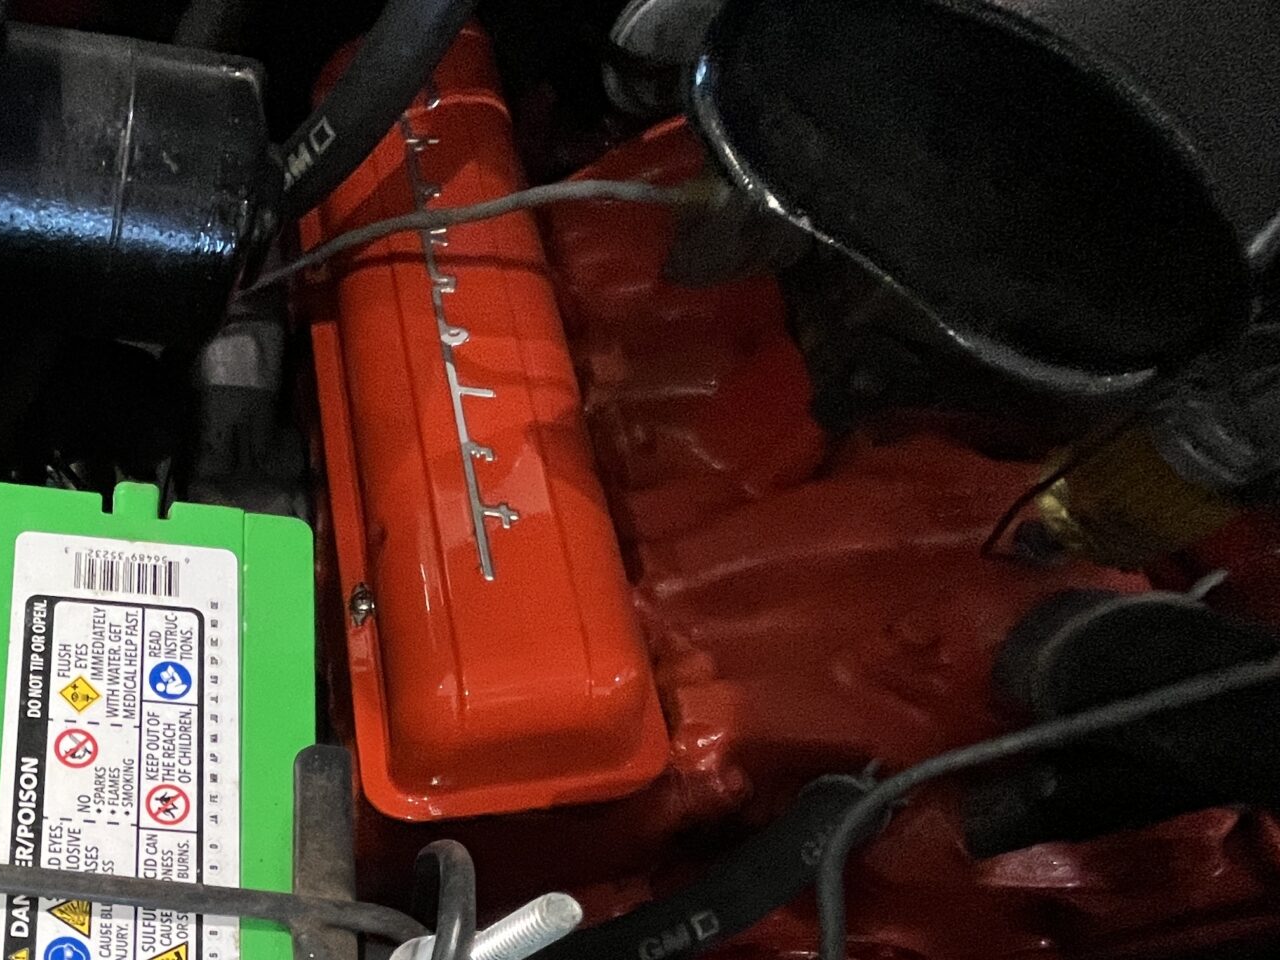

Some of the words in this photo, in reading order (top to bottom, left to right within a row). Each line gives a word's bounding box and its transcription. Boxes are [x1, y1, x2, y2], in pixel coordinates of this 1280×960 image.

[87, 547, 126, 562] 35232
[131, 551, 169, 566] 56489
[32, 599, 47, 633] OPEN.
[125, 610, 138, 636] FAST.
[31, 635, 45, 652] OR
[90, 607, 105, 680] IMMEDIATELY
[108, 622, 121, 642] GET
[148, 630, 161, 657] READ
[164, 611, 177, 659] INSTRUC-
[180, 626, 192, 660] TIONS.
[30, 653, 44, 671] TIP
[57, 643, 71, 677] FLUSH
[74, 643, 88, 668] EYES
[107, 644, 120, 685] WATER.
[124, 638, 137, 665] HELP
[28, 673, 43, 697] NOT
[122, 667, 136, 719] MEDICAL
[27, 699, 42, 717] DO
[105, 688, 119, 717] WITH
[147, 711, 160, 725] OF
[146, 727, 159, 750] OUT
[162, 722, 175, 758] REACH
[179, 707, 191, 766] CHILDREN.
[145, 753, 159, 780] KEEP
[162, 760, 175, 781] THE
[178, 768, 191, 783] OF
[93, 766, 106, 805] SPARKS
[107, 767, 120, 806] FLAMES
[121, 758, 134, 807] SMOKING
[77, 794, 91, 812] NO
[10, 756, 39, 937] DANER/POISON
[48, 821, 63, 853] EYES.
[66, 827, 81, 870] LOSIVE
[145, 833, 157, 854] CAN
[143, 857, 157, 879] CID
[177, 839, 189, 878] BURNS.
[99, 922, 112, 957] CAUSE
[141, 907, 156, 952] SULFU
[160, 911, 172, 946] CAUSE
[176, 922, 188, 939] OR
